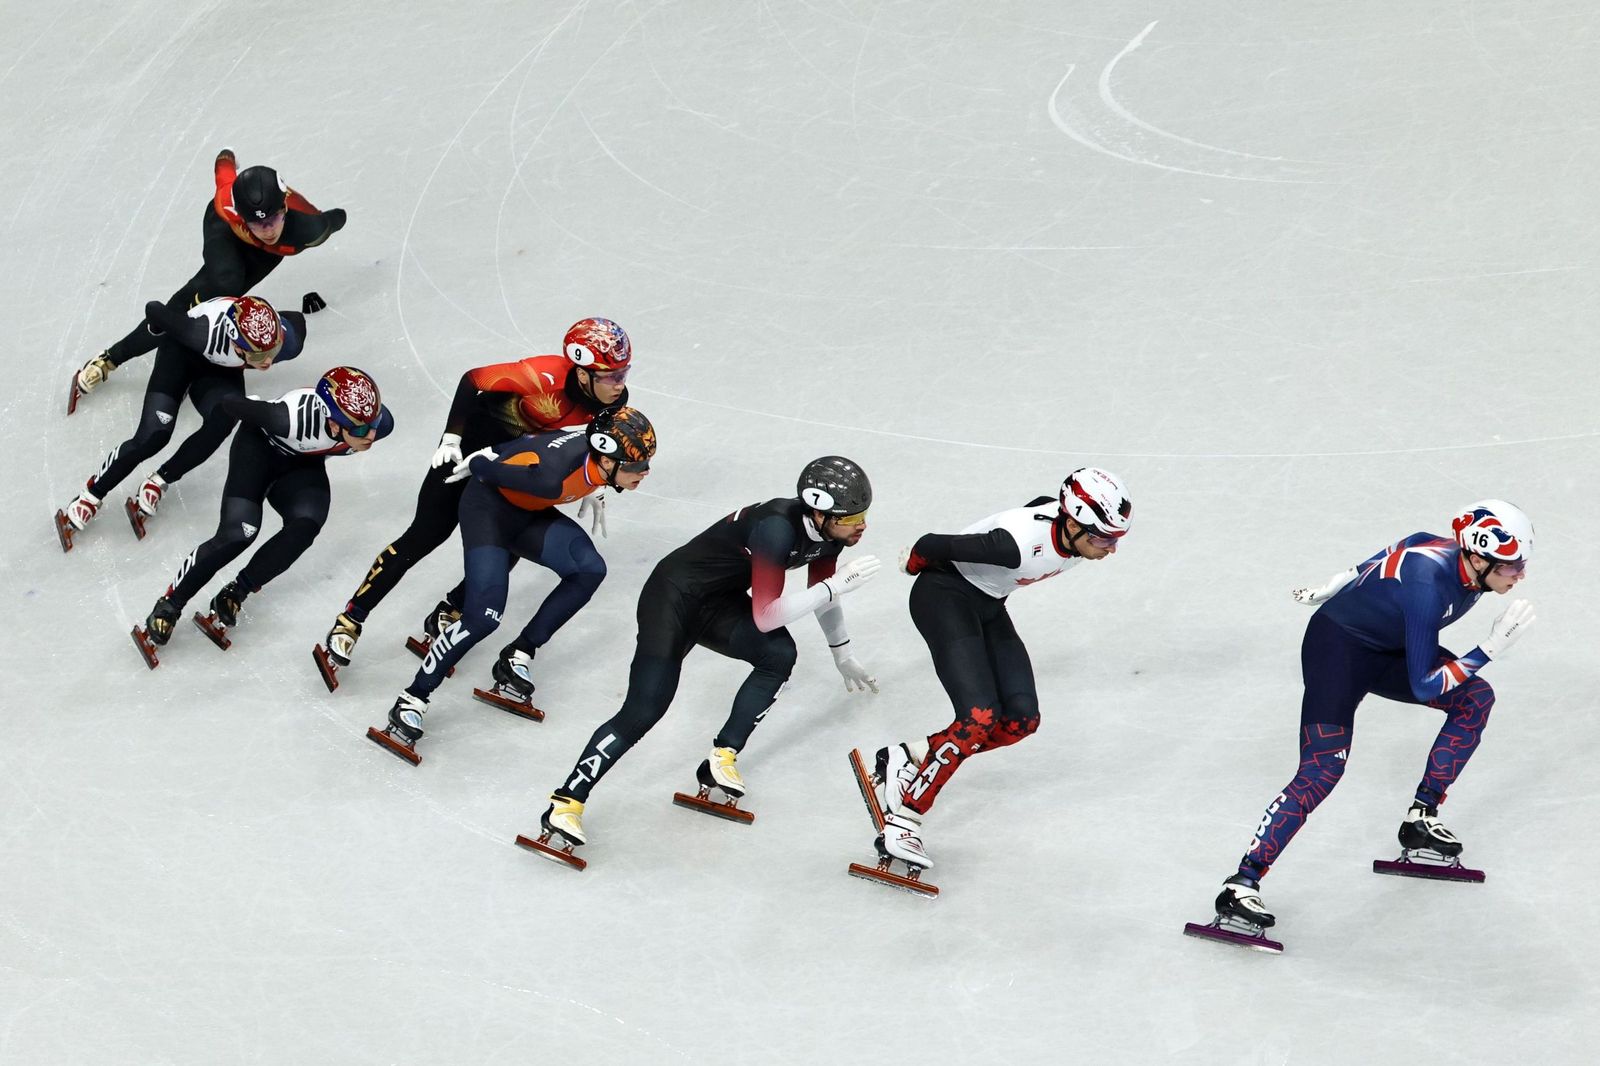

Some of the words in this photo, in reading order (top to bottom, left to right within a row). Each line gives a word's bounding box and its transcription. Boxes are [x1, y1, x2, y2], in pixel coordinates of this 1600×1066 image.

[574, 348, 582, 361] 9
[598, 436, 607, 450] 2
[812, 493, 820, 506] 7
[1471, 531, 1489, 549] 16
[421, 619, 471, 675] NED
[568, 733, 617, 792] LAT
[906, 741, 960, 801] CAN
